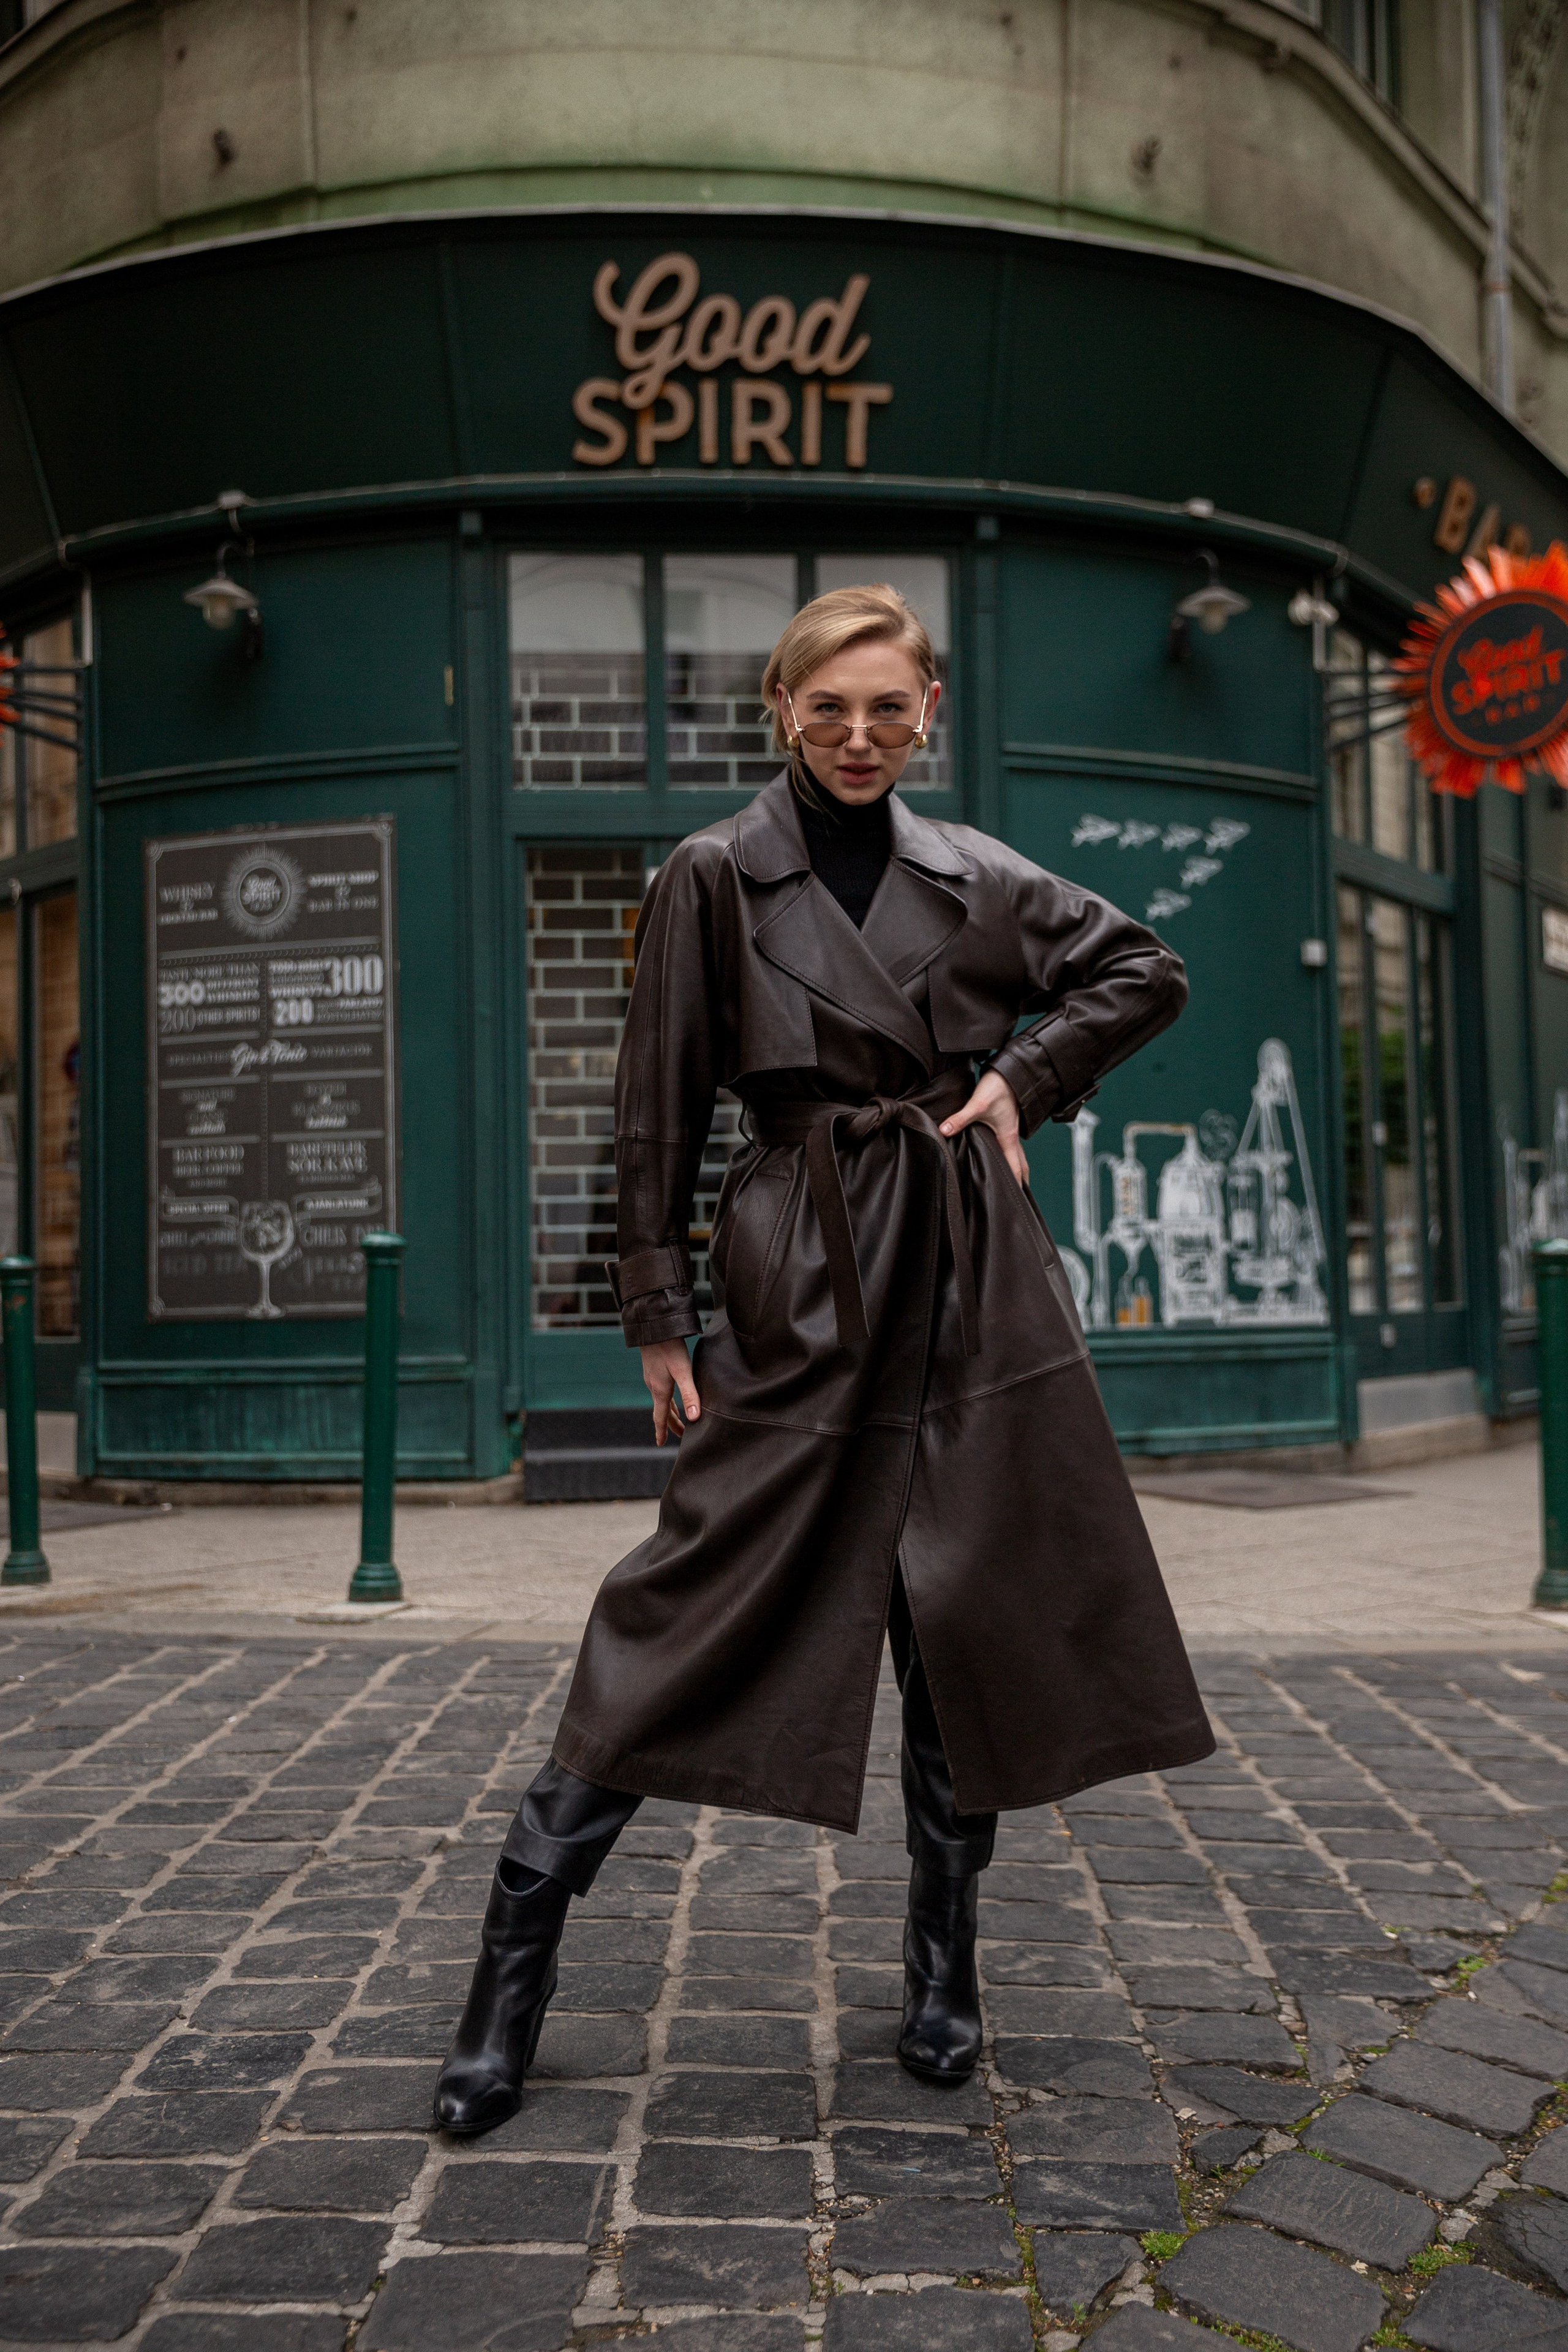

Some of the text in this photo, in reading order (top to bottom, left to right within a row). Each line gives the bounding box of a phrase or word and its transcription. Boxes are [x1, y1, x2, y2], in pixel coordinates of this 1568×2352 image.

[593, 251, 872, 409] Good
[571, 376, 894, 467] SPIRIT
[159, 981, 205, 1008] 300
[323, 955, 383, 997] 300
[274, 998, 315, 1026] 200
